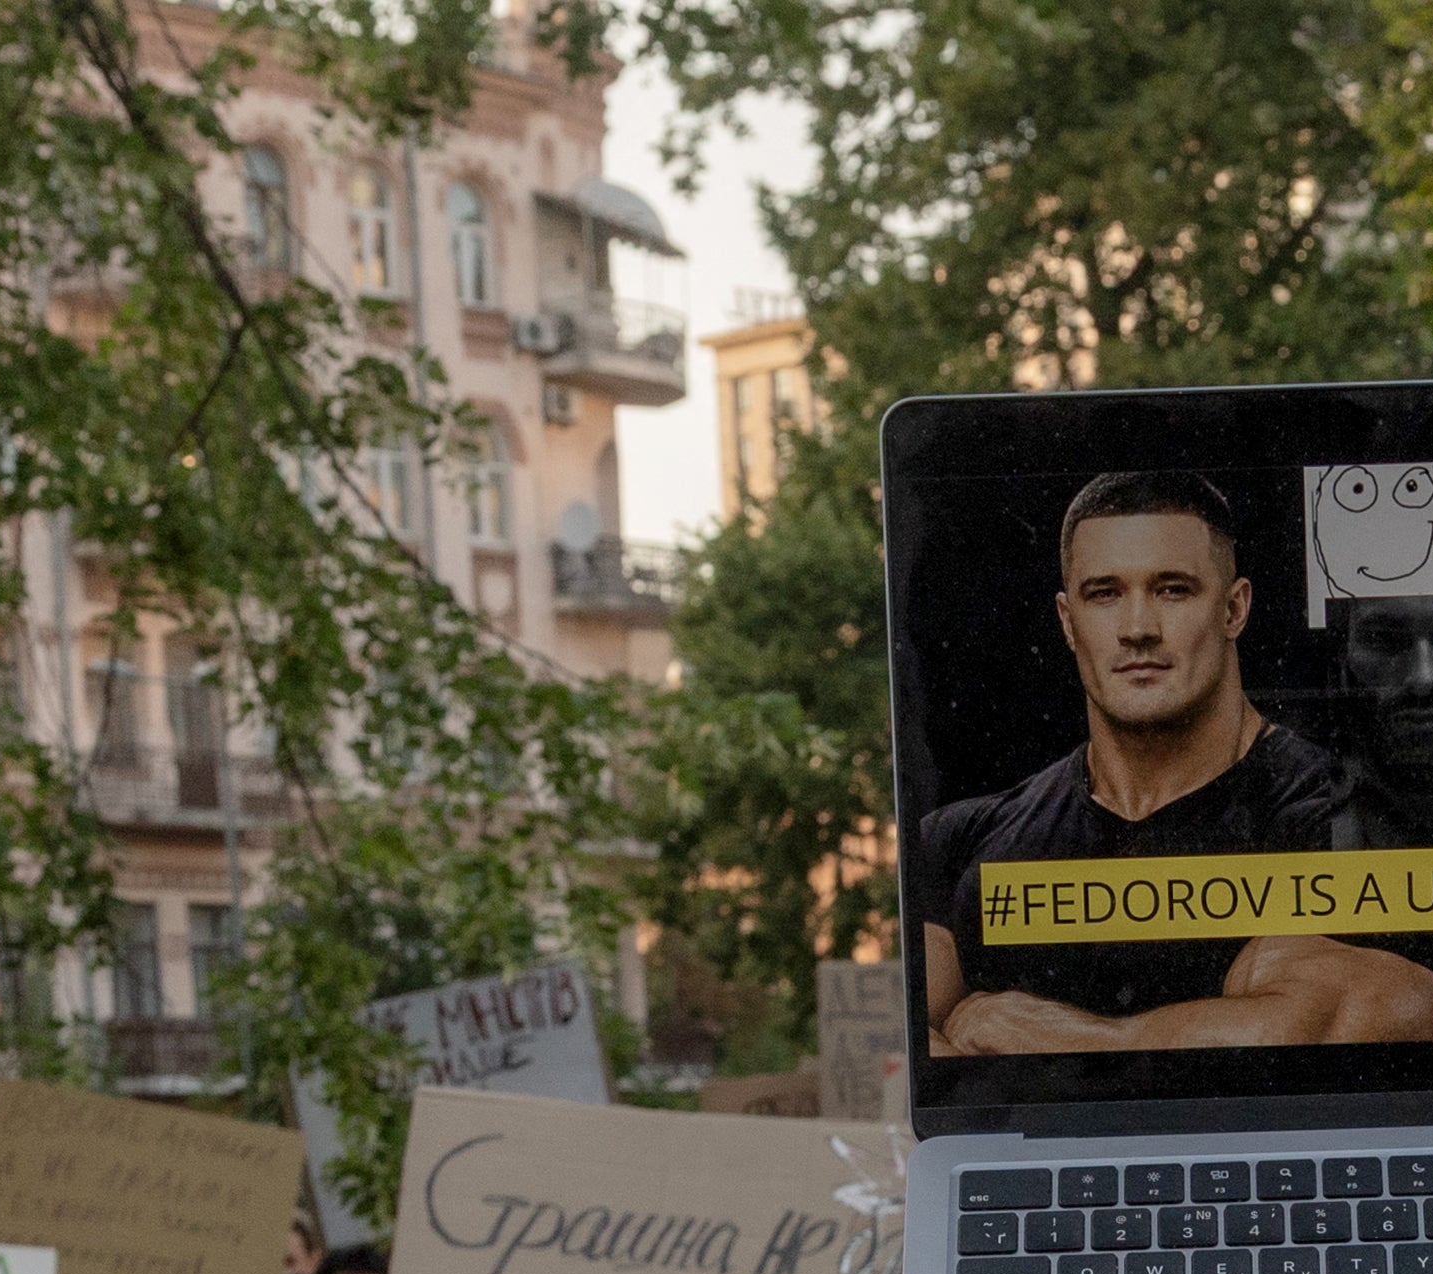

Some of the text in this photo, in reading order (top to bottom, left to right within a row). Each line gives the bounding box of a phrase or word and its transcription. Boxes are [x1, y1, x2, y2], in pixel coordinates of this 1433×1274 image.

[984, 877, 1273, 926] #FEDOROV
[1290, 874, 1336, 916] IS
[1354, 873, 1388, 914] A
[1249, 1225, 1259, 1235] 4
[1317, 1223, 1326, 1234] 5
[1383, 1220, 1394, 1231] 6
[1051, 1232, 1057, 1242] 1
[1117, 1230, 1126, 1240] 2
[1183, 1227, 1193, 1238] 3
[1284, 1261, 1294, 1272] R
[1351, 1259, 1362, 1269] T
[1418, 1257, 1428, 1268] Y
[1217, 1263, 1226, 1274] E
